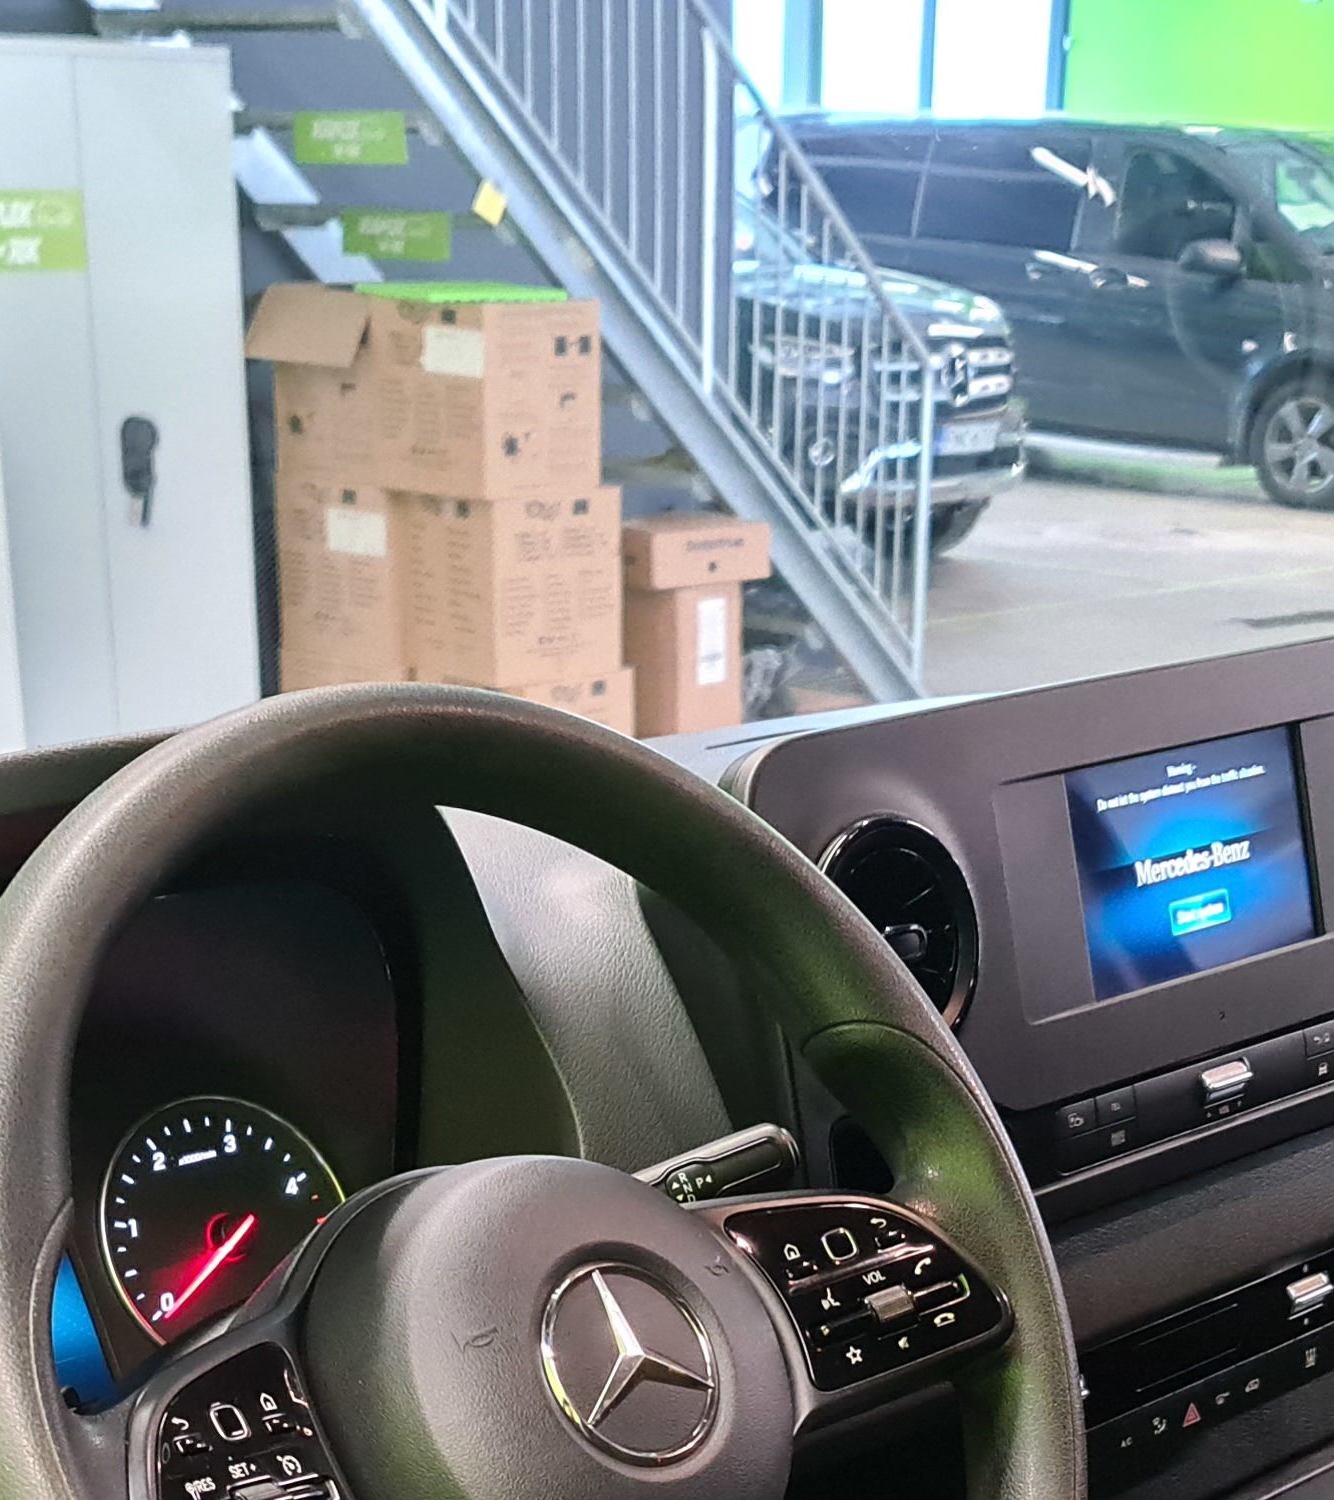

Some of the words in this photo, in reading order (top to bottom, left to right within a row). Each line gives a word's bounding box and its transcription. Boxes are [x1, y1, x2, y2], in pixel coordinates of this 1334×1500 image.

[1134, 841, 1250, 888] Mercedes-Benz
[223, 1134, 237, 1152] 3
[152, 1151, 166, 1171] 2
[285, 1177, 299, 1195] 4
[678, 1172, 688, 1183] R
[695, 1177, 704, 1189] P
[682, 1184, 693, 1194] N
[687, 1194, 696, 1203] D
[128, 1219, 138, 1237] 1
[862, 1270, 886, 1285] VOL
[160, 1291, 174, 1311] 0
